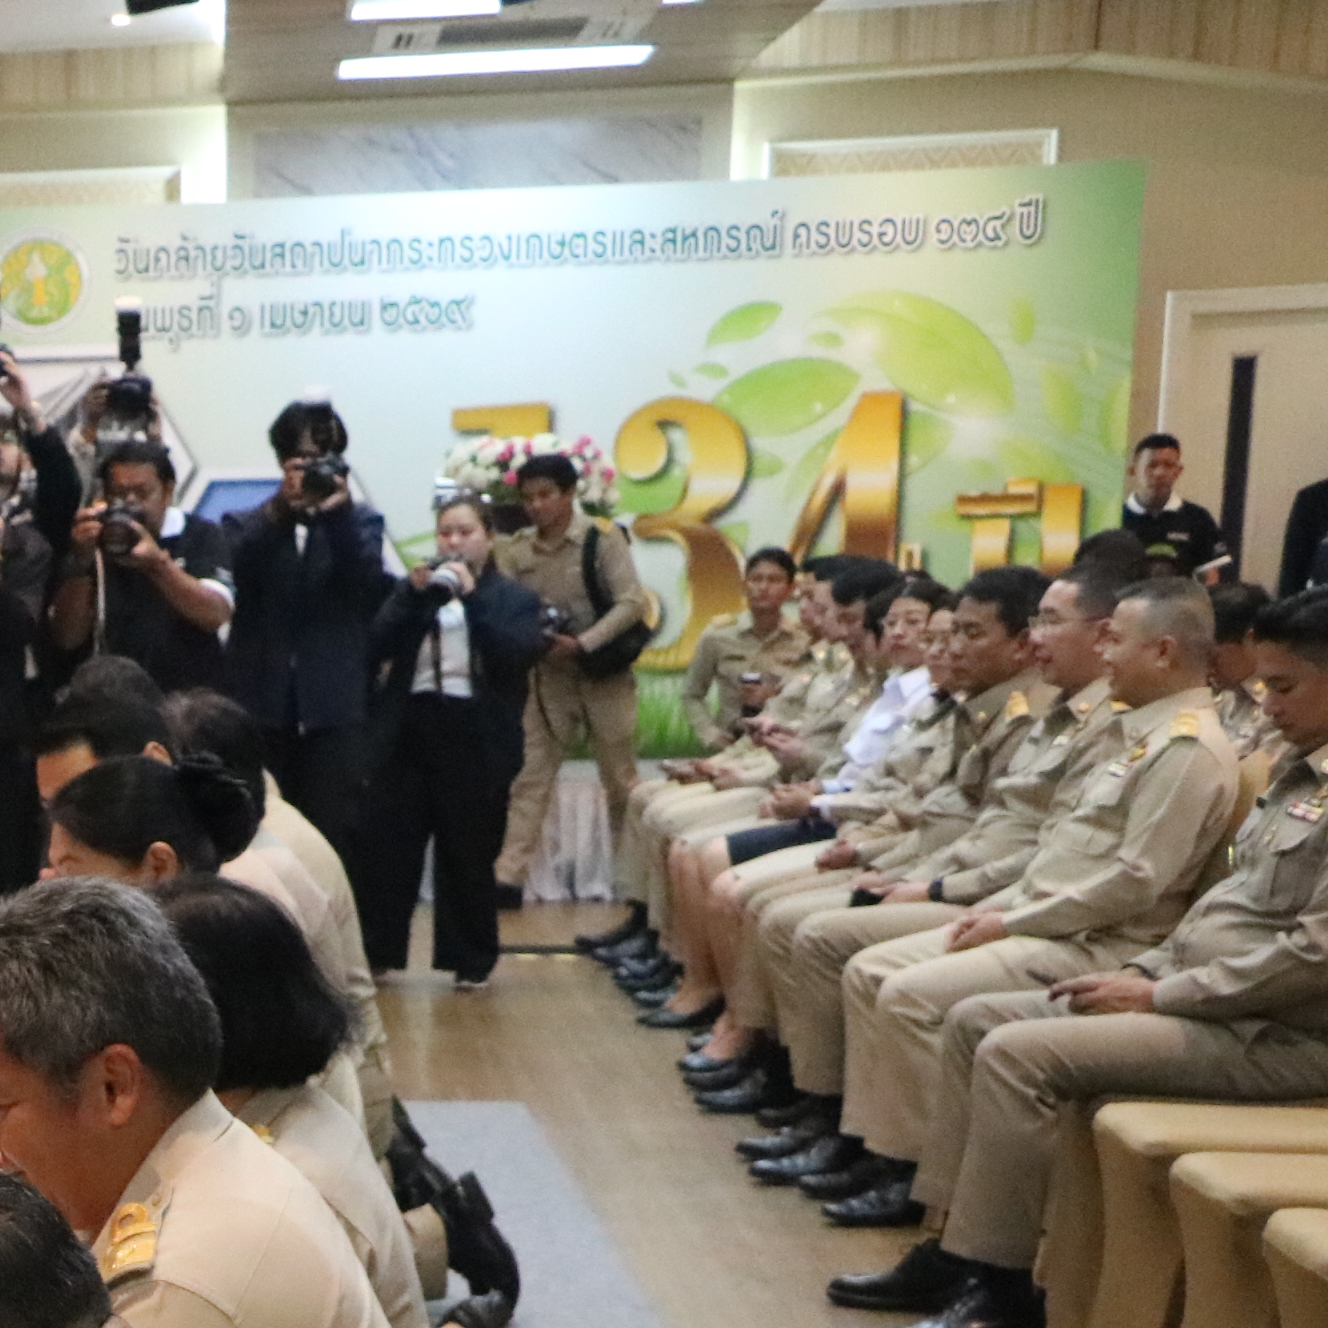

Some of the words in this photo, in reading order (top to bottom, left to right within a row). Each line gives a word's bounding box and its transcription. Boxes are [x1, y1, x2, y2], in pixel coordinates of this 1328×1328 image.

[792, 216, 923, 256] ครบรอบ
[1017, 196, 1044, 243] ปี
[261, 298, 367, 331] เมษายน
